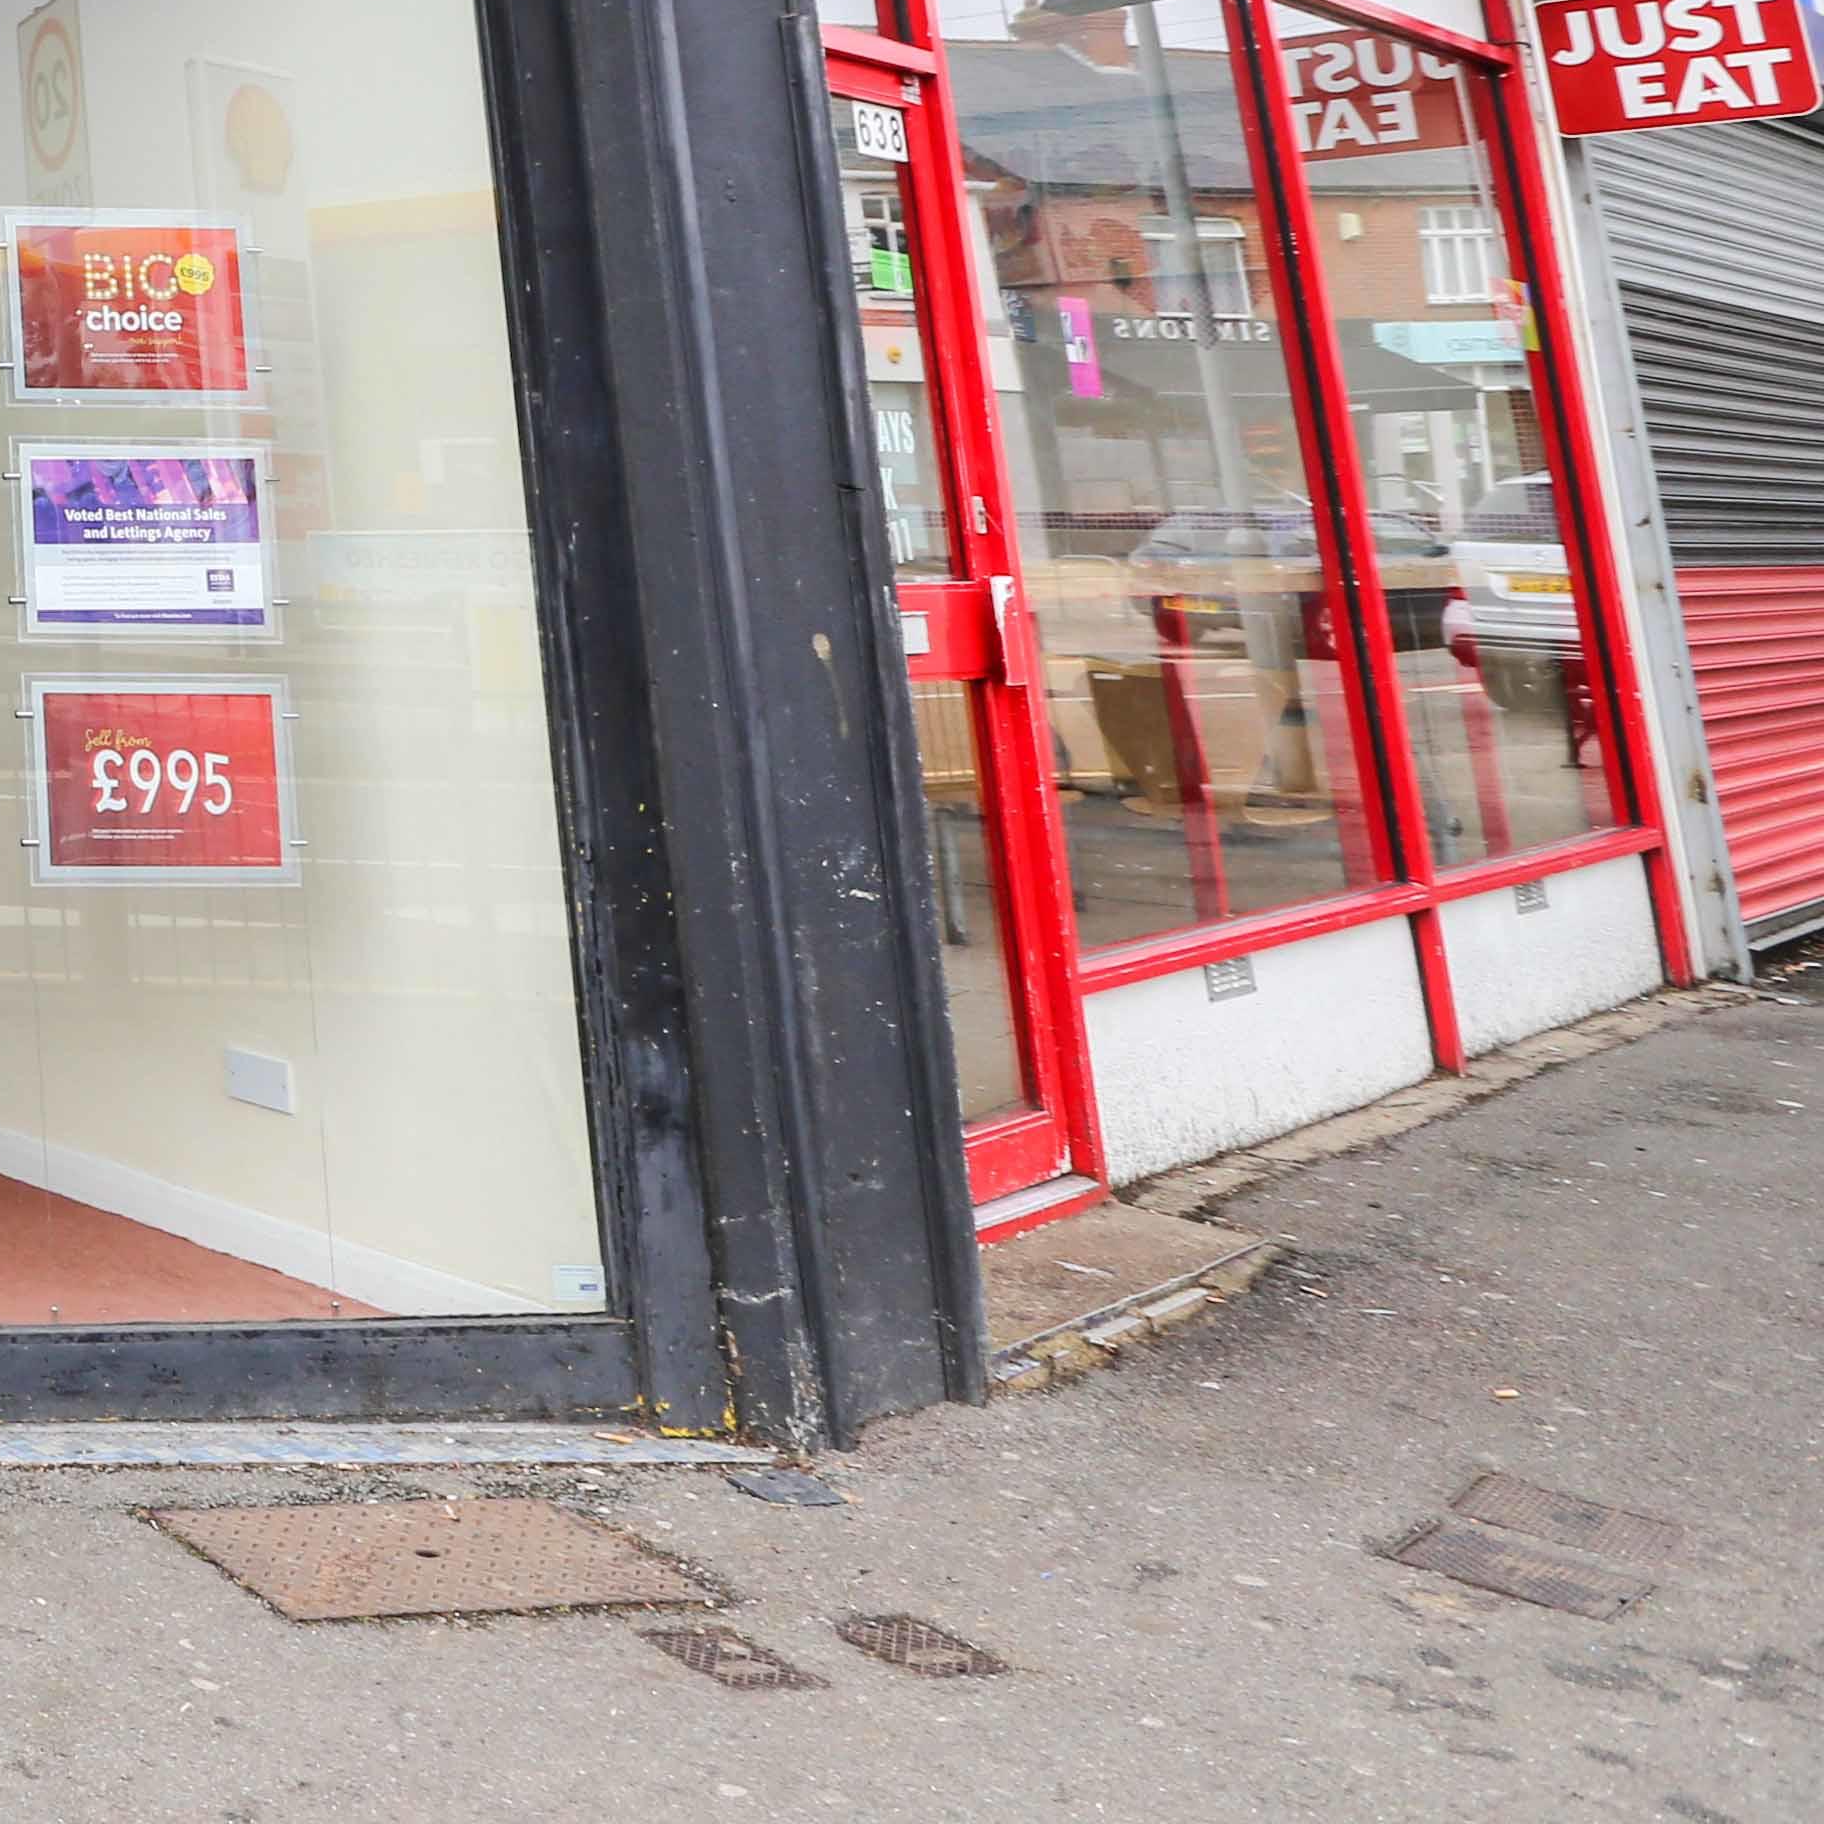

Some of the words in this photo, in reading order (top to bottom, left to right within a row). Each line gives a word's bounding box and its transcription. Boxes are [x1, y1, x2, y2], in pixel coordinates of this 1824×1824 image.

[1613, 47, 1793, 120] EAT
[858, 108, 903, 153] 638
[85, 304, 184, 332] choice
[64, 507, 103, 522] Voted
[105, 507, 134, 522] Best
[136, 507, 191, 522] National
[194, 507, 227, 522] Sales
[83, 526, 108, 539] and
[110, 525, 162, 542] Lettings
[164, 526, 212, 543] Agency
[84, 728, 113, 753] Sell
[115, 728, 153, 751] from
[90, 748, 233, 816] £995
